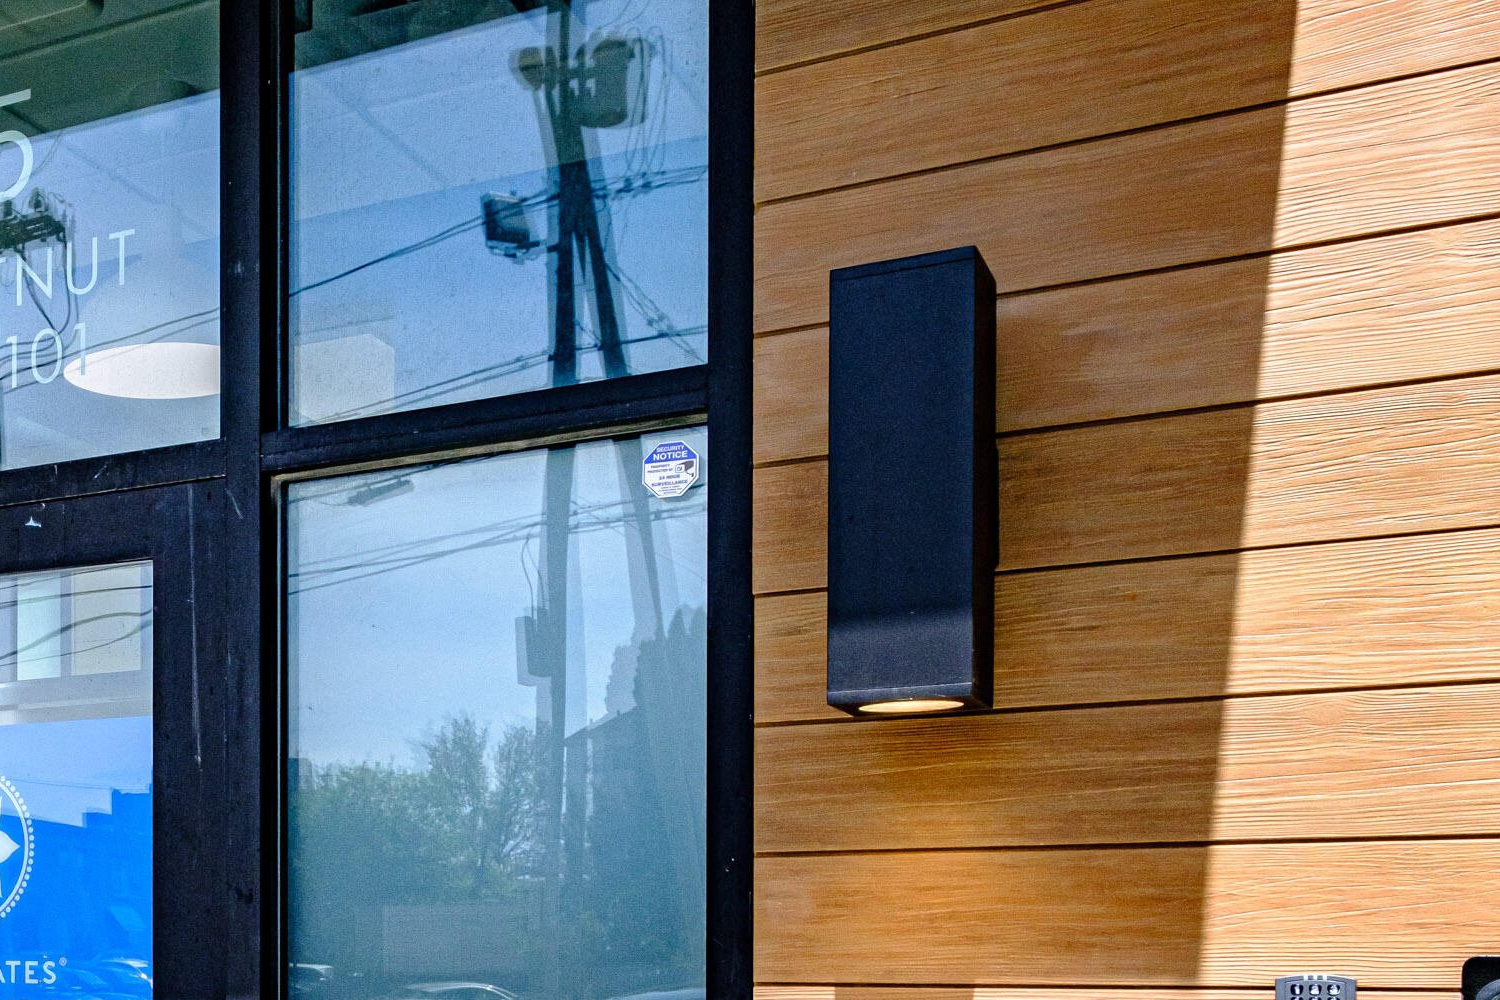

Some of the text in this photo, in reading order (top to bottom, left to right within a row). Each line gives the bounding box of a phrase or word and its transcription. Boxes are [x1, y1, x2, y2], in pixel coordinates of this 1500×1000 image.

[5, 323, 87, 389] 101
[657, 445, 685, 453] SECURITY
[653, 450, 688, 460] NOTICE
